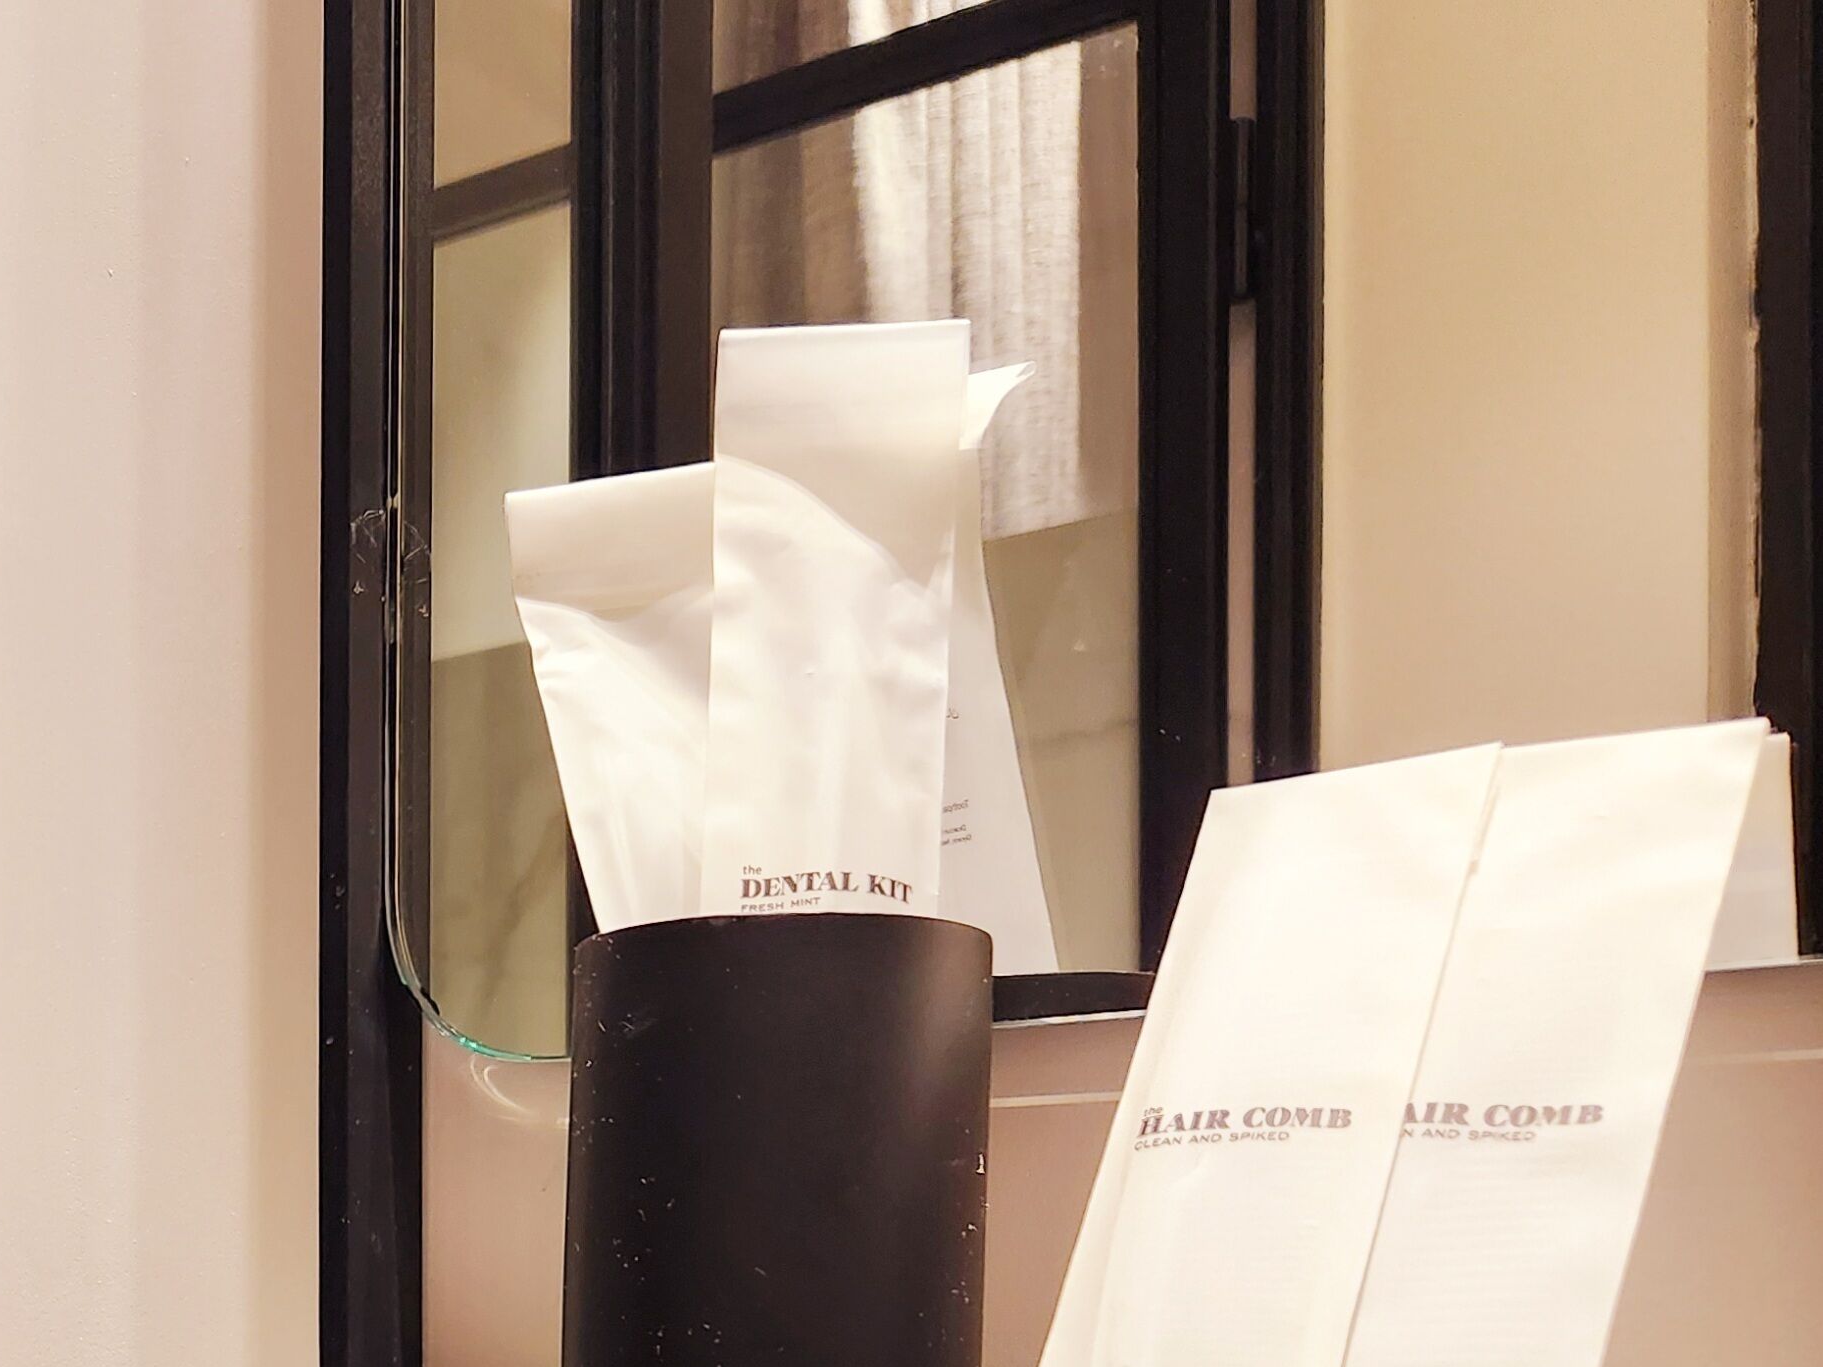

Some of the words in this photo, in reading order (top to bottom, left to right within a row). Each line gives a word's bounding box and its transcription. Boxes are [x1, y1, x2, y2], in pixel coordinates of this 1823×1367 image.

[742, 865, 762, 875] the
[740, 871, 860, 899] DENTAL
[867, 873, 913, 904] KIT
[740, 901, 785, 912] FRESH
[790, 897, 822, 908] MINT
[1136, 1109, 1231, 1138] HAIR
[1242, 1107, 1353, 1128] COMB
[1483, 1104, 1604, 1127] COMB
[1134, 1136, 1183, 1151] CLEAN
[1189, 1132, 1223, 1143] AND
[1229, 1131, 1290, 1142] SPIKED
[1421, 1128, 1461, 1139] AND
[1467, 1130, 1537, 1141] SPIKED
